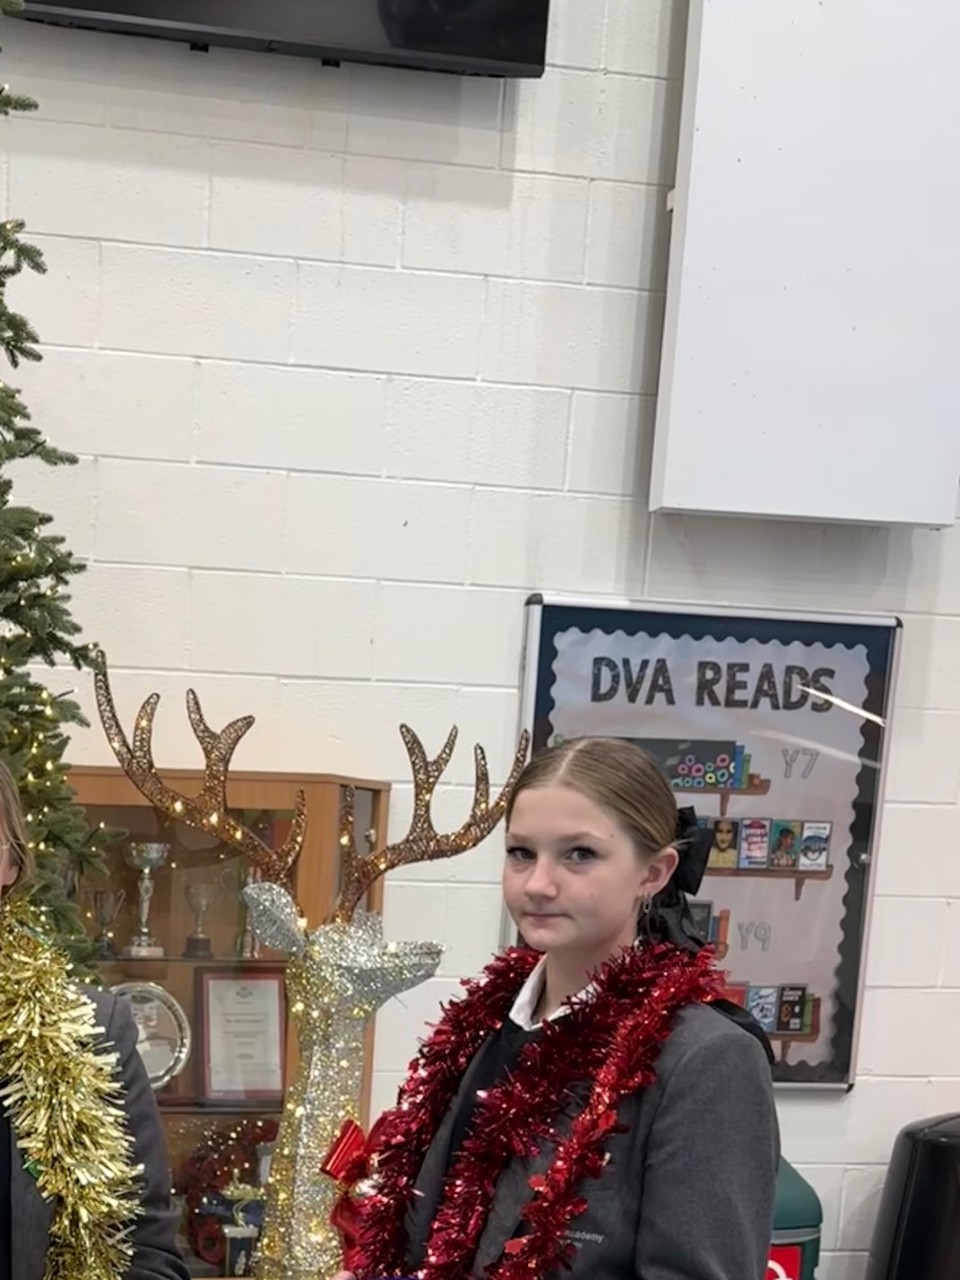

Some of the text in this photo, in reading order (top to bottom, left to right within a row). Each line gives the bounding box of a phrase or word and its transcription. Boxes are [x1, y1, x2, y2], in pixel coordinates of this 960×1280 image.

[590, 656, 836, 714] DVA READS
[782, 748, 820, 780] Y7
[737, 921, 772, 952] Y9
